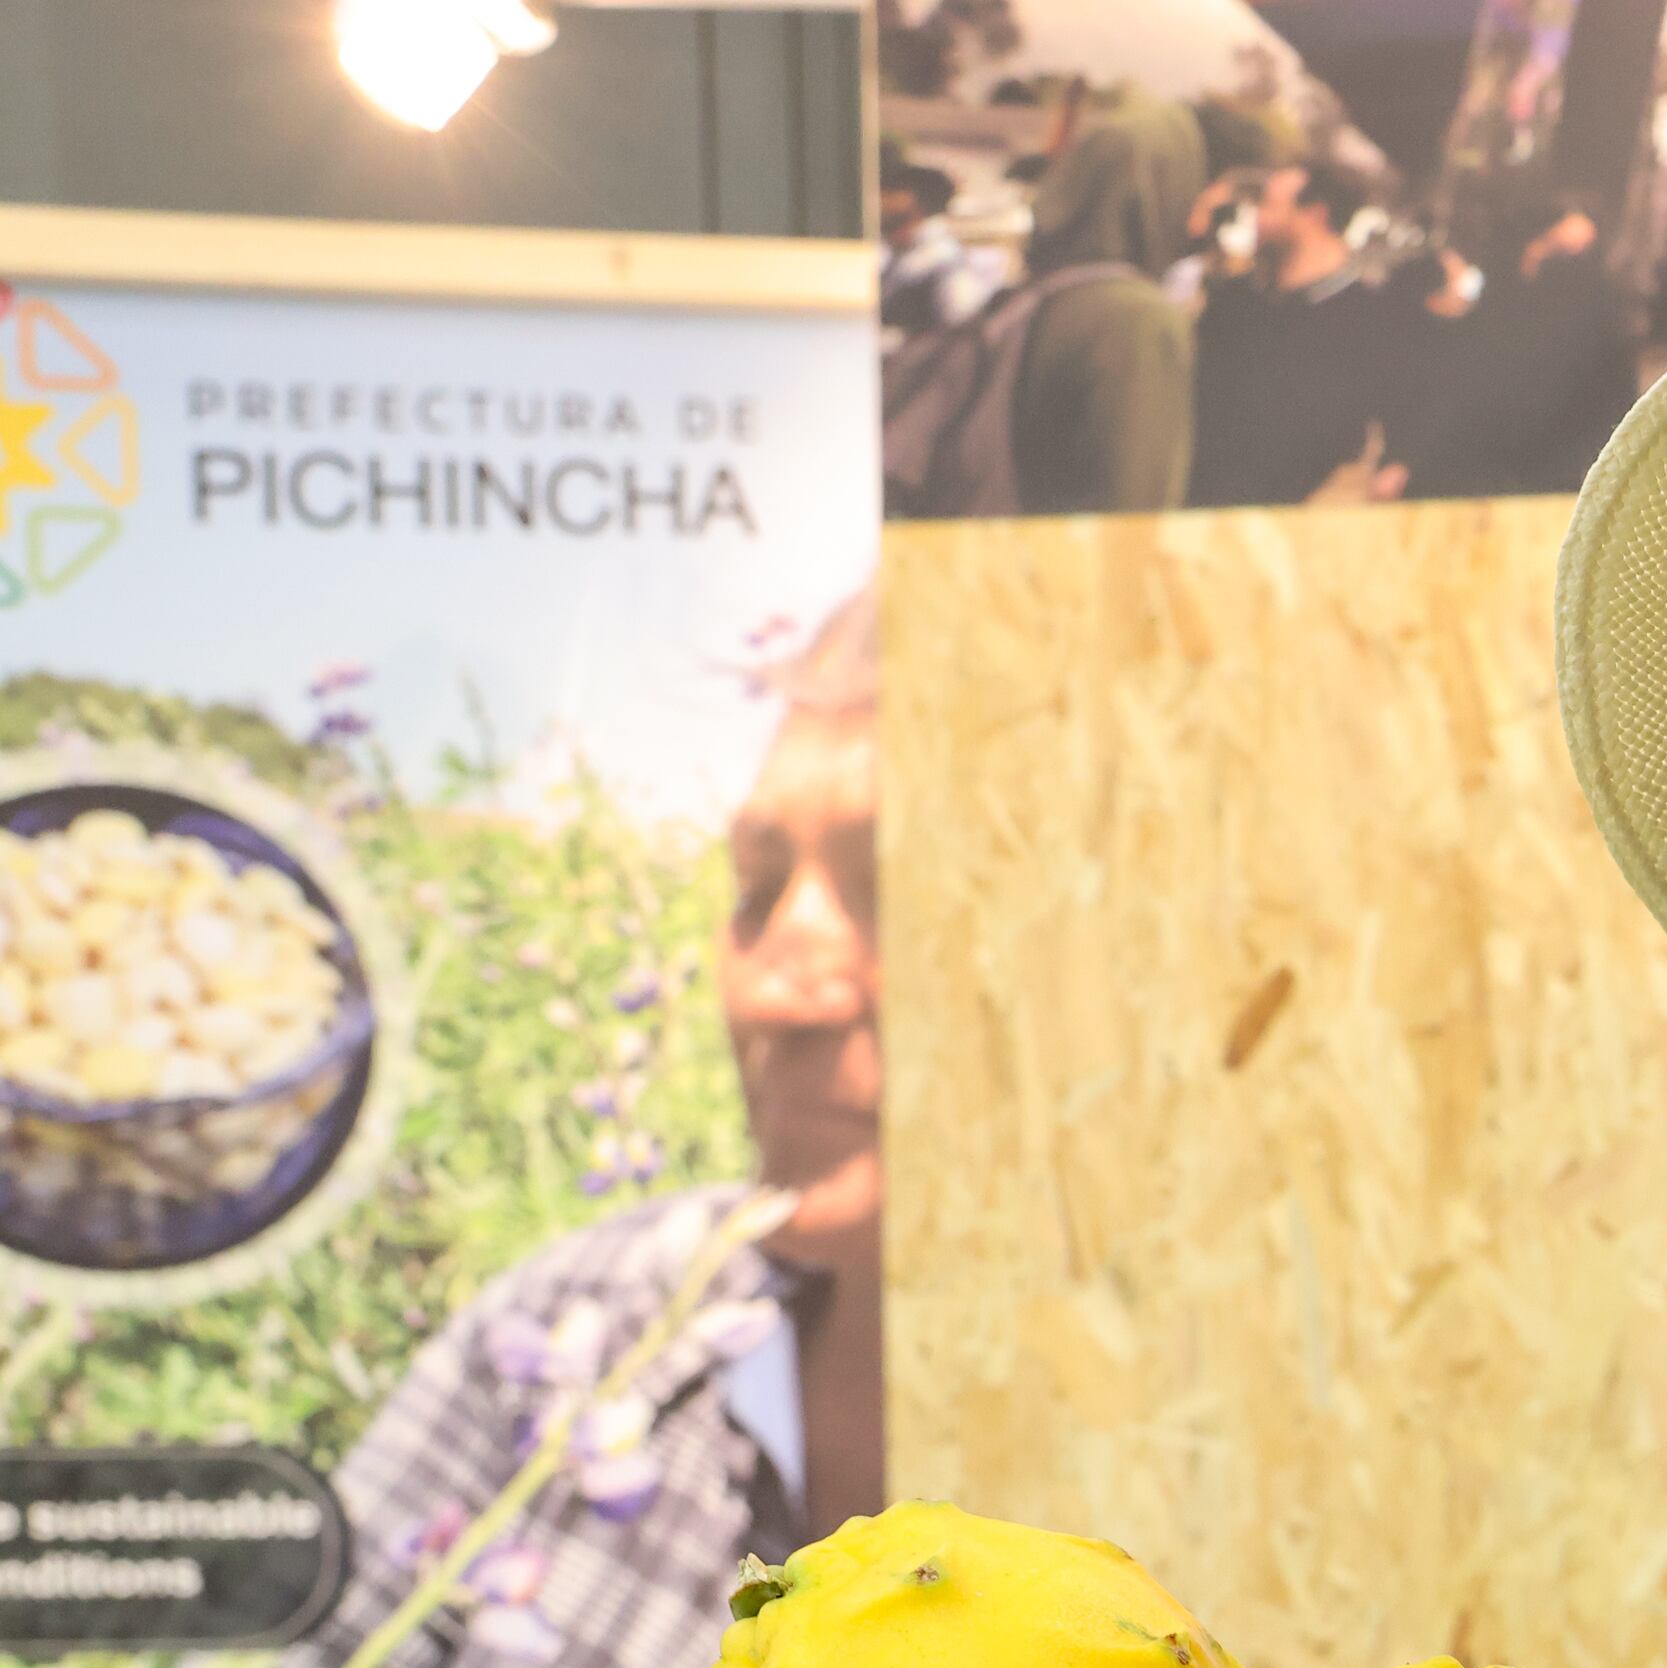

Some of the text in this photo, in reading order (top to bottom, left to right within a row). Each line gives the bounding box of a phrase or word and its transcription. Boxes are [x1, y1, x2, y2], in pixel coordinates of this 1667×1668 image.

[187, 377, 761, 442] PREFECTURA DE
[192, 447, 757, 537] PICHINCHA
[29, 1492, 320, 1539] sustainable
